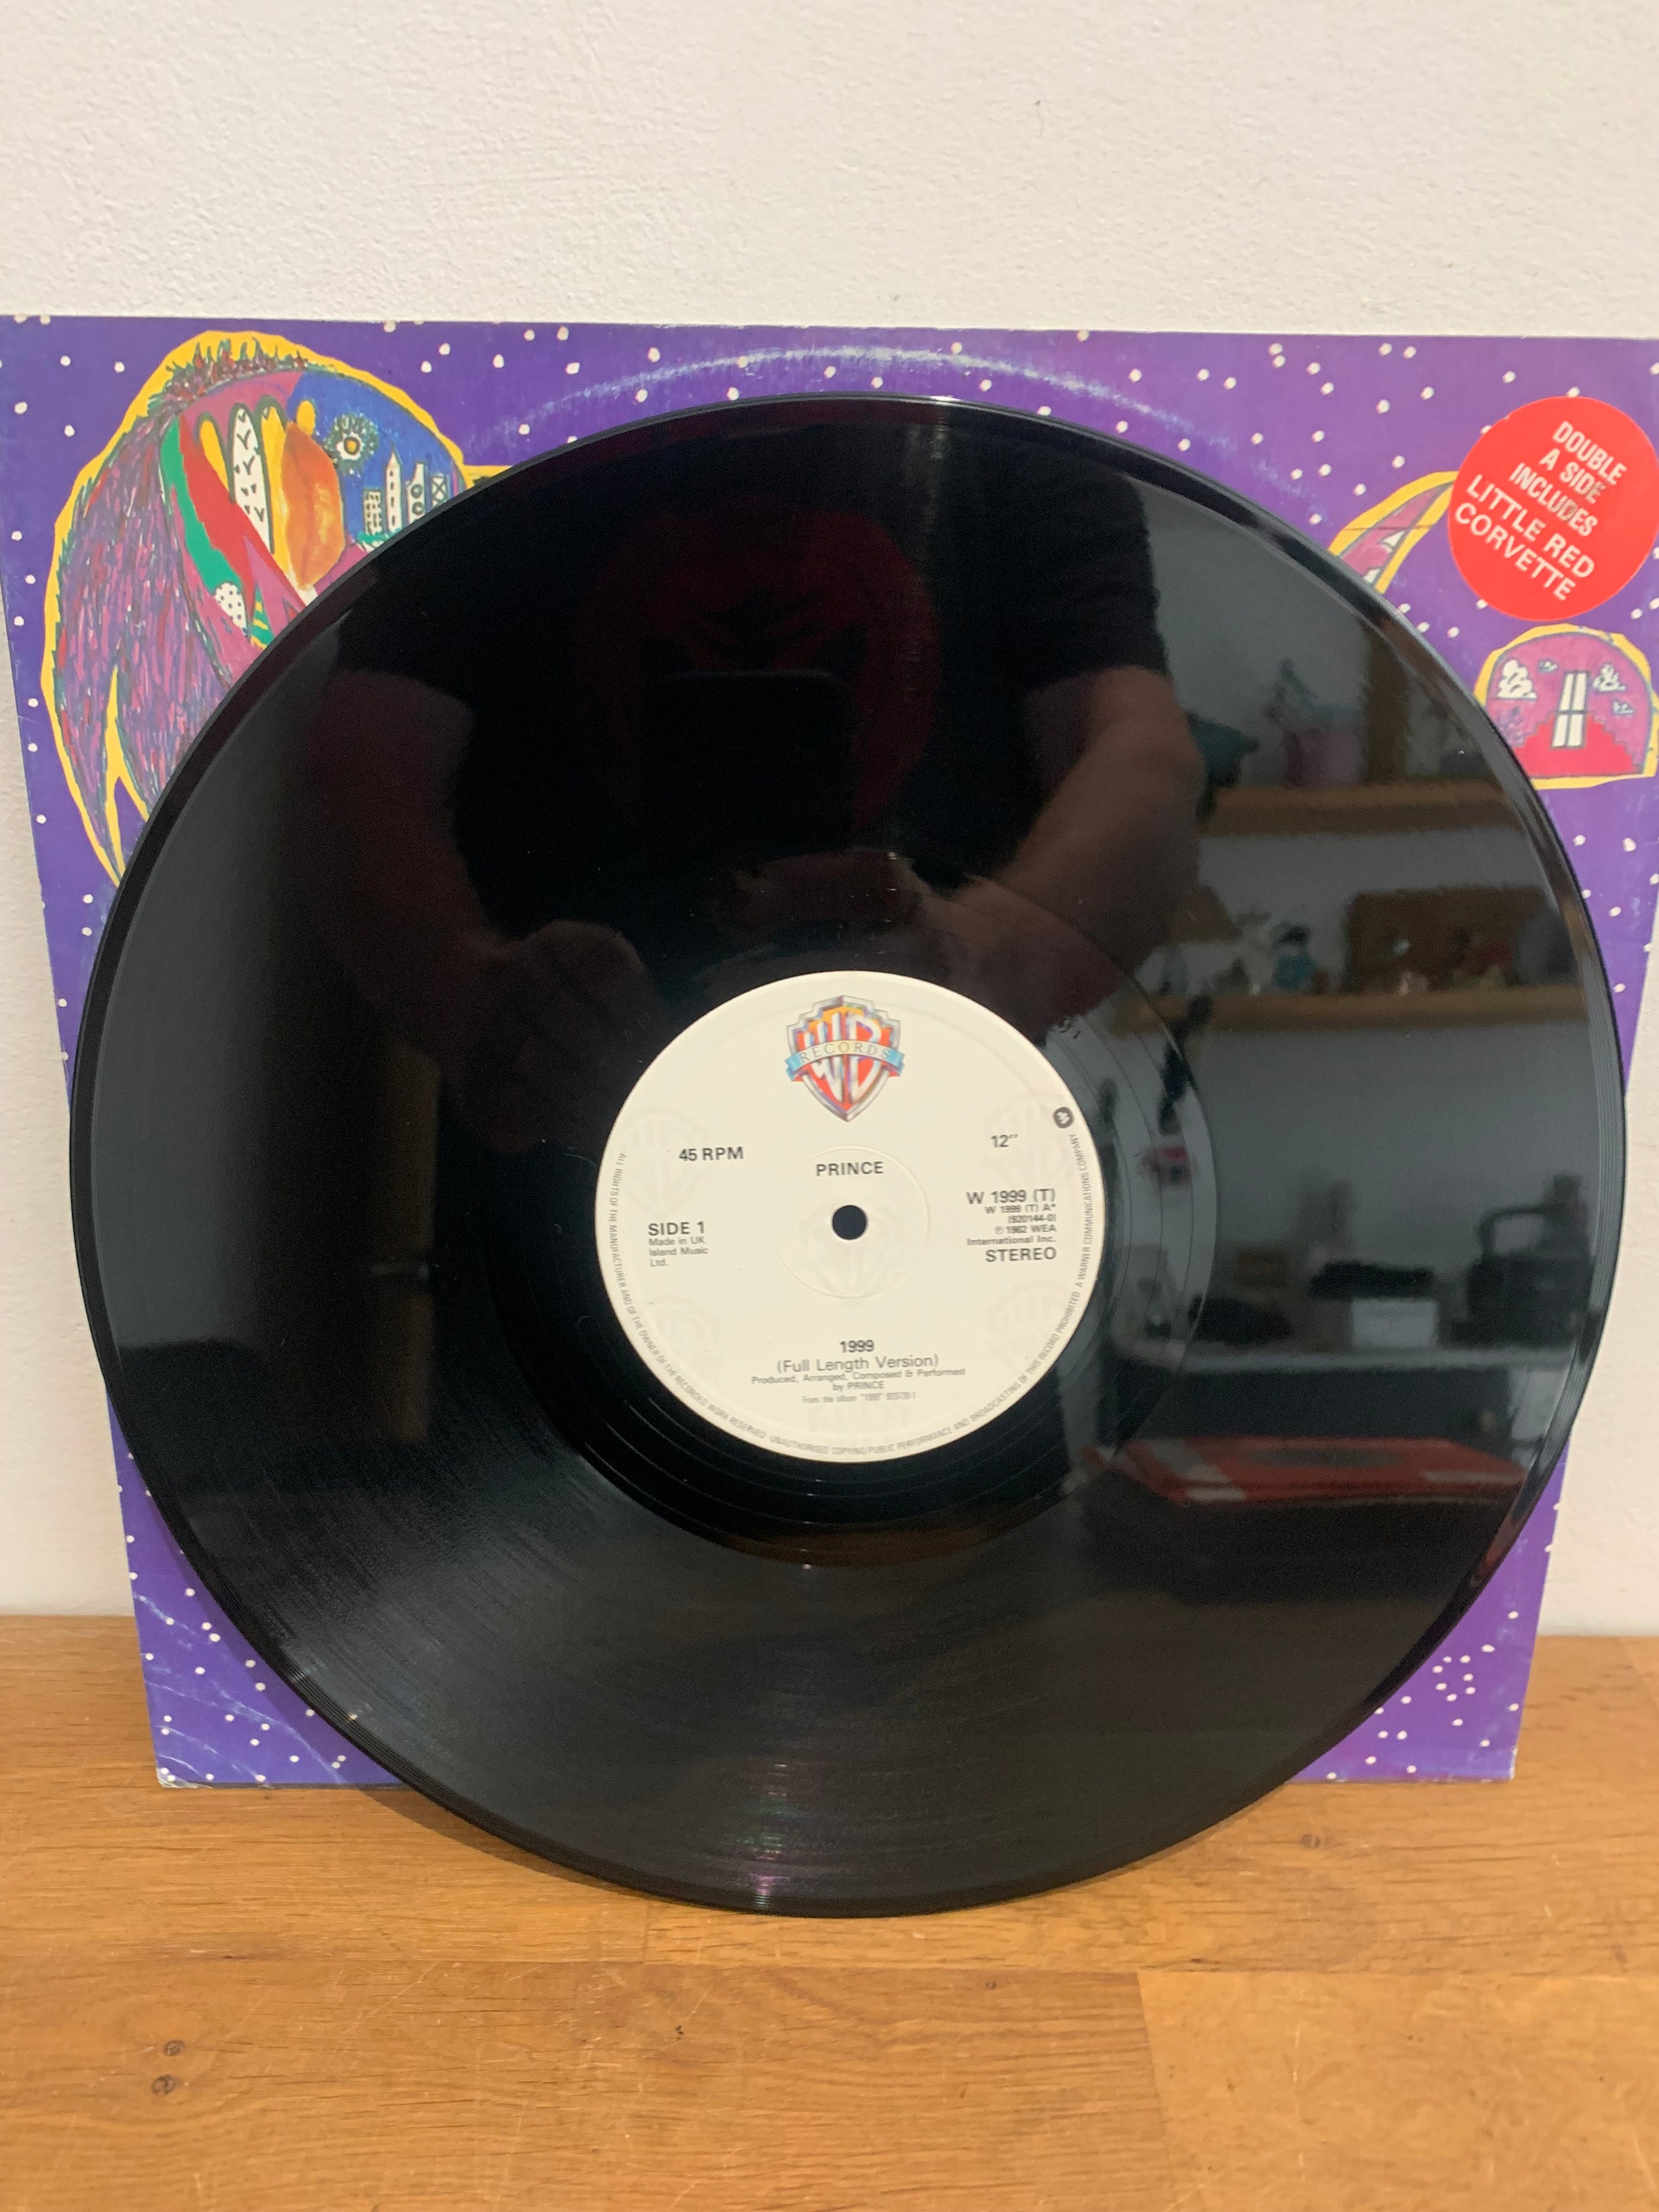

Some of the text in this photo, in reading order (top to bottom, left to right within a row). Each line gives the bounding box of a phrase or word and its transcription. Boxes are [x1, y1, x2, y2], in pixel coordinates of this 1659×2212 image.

[1553, 421, 1626, 484] DOUBLE
[1540, 448, 1606, 504] A SIDE
[1509, 463, 1598, 536] INCLUDES
[1467, 474, 1594, 578] LITTLE RED
[1455, 502, 1576, 600] CORVETTE
[800, 1041, 890, 1063] RECORDS
[615, 1152, 628, 1166] ALL
[679, 1146, 744, 1161] 45 RPM
[1067, 1131, 1088, 1171] COMPANY
[816, 1161, 884, 1176] PRINCE
[609, 1168, 623, 1196] RIGHTS
[608, 1197, 618, 1207] OF
[966, 1188, 1056, 1204] W 1999 (T)
[608, 1209, 617, 1222] THE
[1000, 1205, 1022, 1213] 1999
[1025, 1204, 1039, 1213] (T)
[1079, 1172, 1093, 1244] COMMUNICATIONS
[648, 1221, 705, 1236] SIDE 1
[1030, 1224, 1057, 1233] WEA
[648, 1235, 706, 1246] Made in UK
[967, 1234, 1057, 1245] International Inc.
[608, 1225, 628, 1288] MANUFACTURER
[649, 1246, 708, 1256] Island Music
[985, 1246, 1057, 1262] STEREO
[650, 1258, 669, 1267] Ltd.
[1076, 1246, 1092, 1281] WARNER
[619, 1288, 633, 1306] AND
[625, 1305, 638, 1317] OF
[630, 1315, 644, 1331] THE
[1025, 1358, 1043, 1376] THIS
[1036, 1332, 1061, 1361] RECORD
[1053, 1291, 1081, 1334] PROHIBITED
[638, 1329, 661, 1357] OWNER
[839, 1339, 875, 1353] 1999
[777, 1354, 938, 1374] (Full Length Version)
[852, 1370, 902, 1380] Composed
[917, 1368, 966, 1377] Performed
[832, 1381, 885, 1392] by PRINCE
